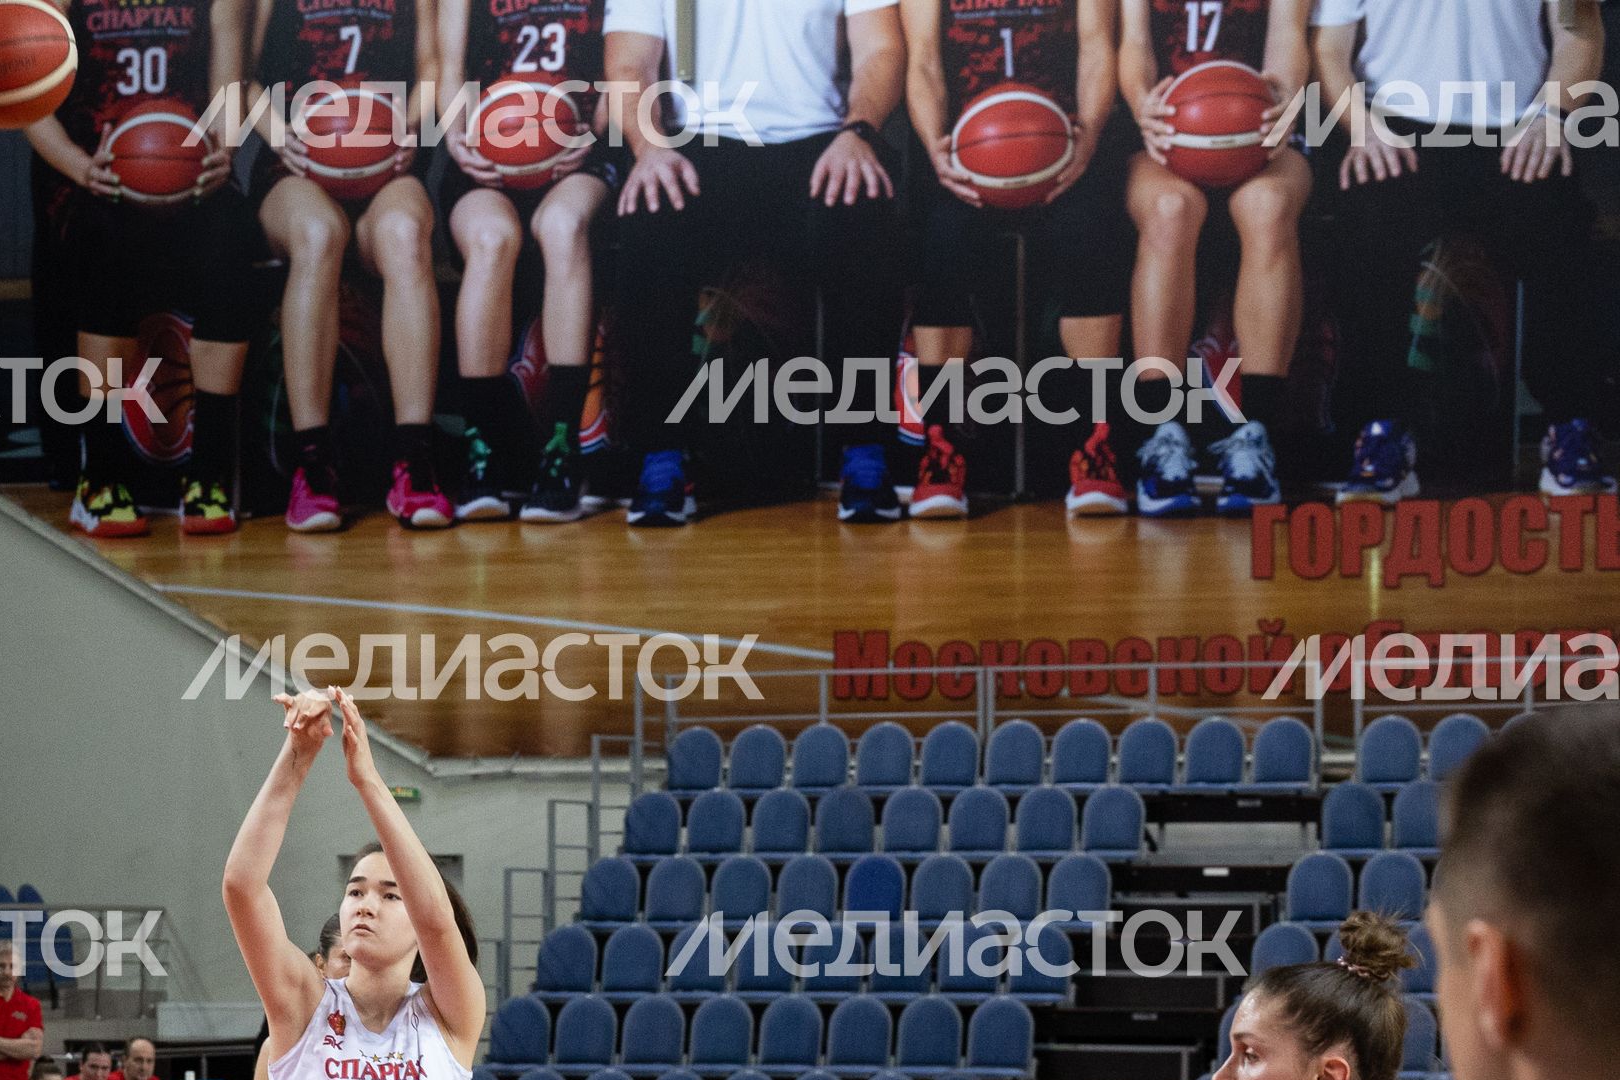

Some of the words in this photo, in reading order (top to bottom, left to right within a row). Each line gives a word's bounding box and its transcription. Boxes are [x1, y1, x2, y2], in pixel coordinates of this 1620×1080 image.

[339, 25, 362, 75] 7
[511, 22, 567, 73] 23
[1186, 1, 1223, 53] 17
[115, 46, 168, 96] 30
